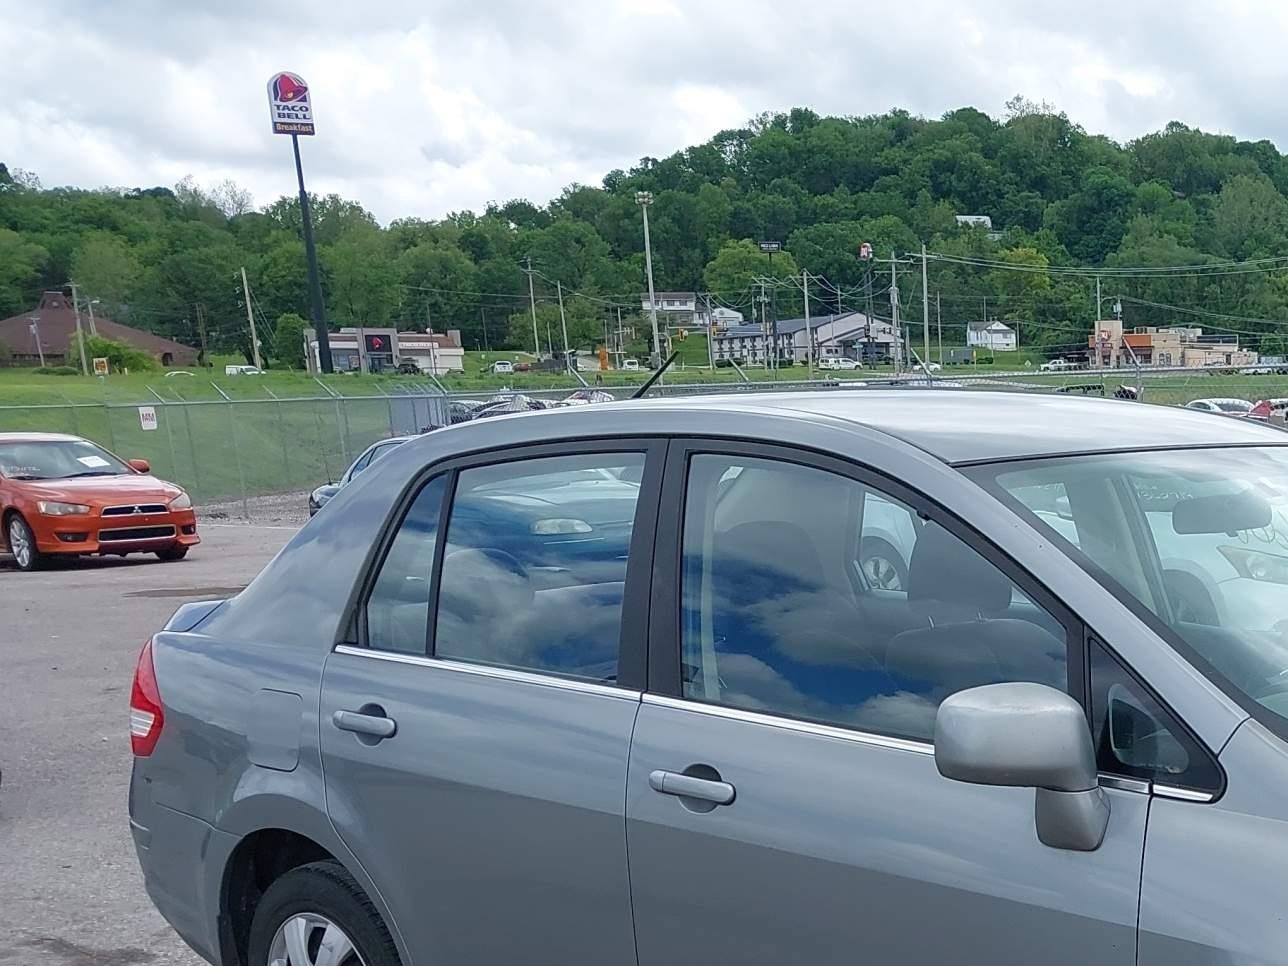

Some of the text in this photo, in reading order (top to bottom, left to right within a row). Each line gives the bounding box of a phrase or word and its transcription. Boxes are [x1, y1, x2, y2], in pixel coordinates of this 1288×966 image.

[273, 104, 309, 112] TACO
[277, 112, 311, 120] BELL
[276, 123, 313, 132] Breakfast
